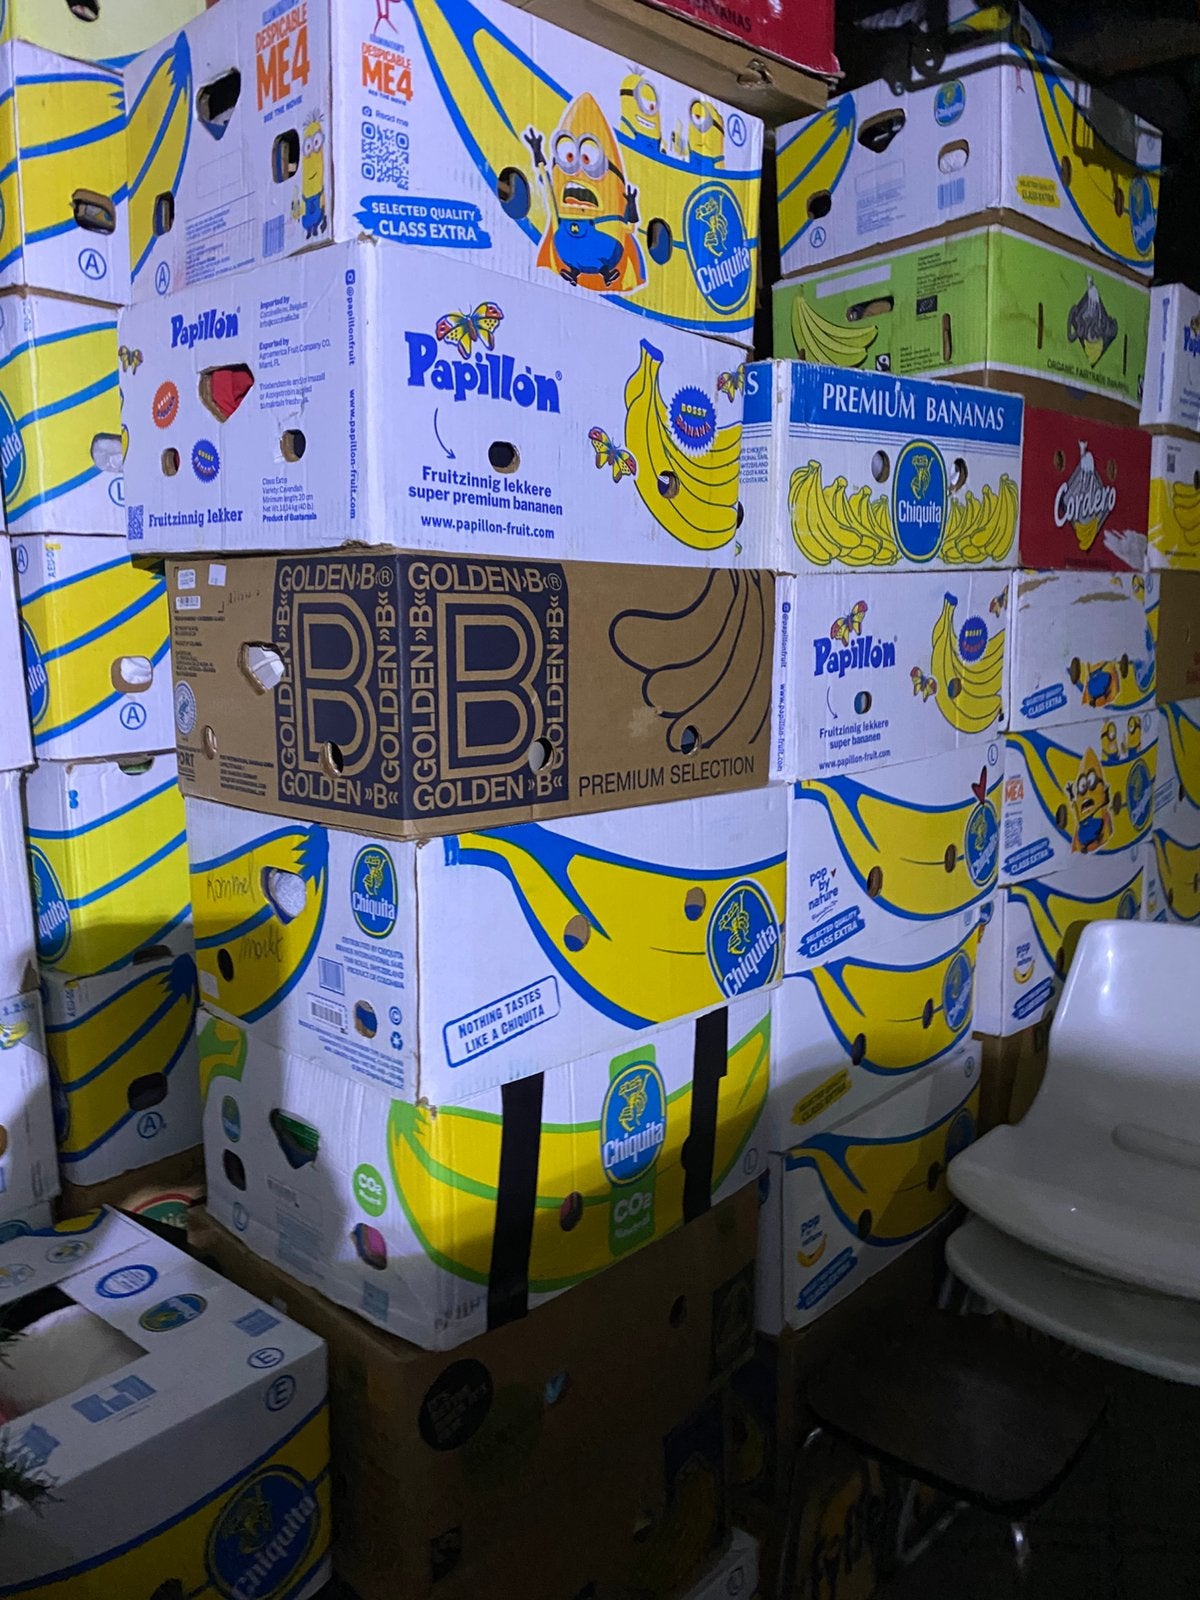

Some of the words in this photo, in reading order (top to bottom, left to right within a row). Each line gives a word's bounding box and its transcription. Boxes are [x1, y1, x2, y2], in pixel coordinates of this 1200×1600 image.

[371, 201, 427, 218] SELECTED
[429, 206, 475, 221] QUALITY
[378, 218, 427, 238] CLASS
[429, 222, 477, 241] EXTRA
[697, 246, 751, 295] Chiquita
[346, 286, 356, 366] @papillonfruit
[681, 402, 707, 417] BOSSY
[822, 382, 916, 420] PREMIUM
[926, 397, 1005, 431] BANANAS
[675, 414, 711, 437] BANANA
[349, 389, 357, 519] www.papillon-fruit.com
[421, 465, 501, 493] Fruitzinnig
[503, 477, 552, 498] lekkere
[408, 485, 450, 502] super
[452, 490, 511, 506] premium
[513, 496, 563, 515] bananen
[899, 500, 942, 529] Chiquita
[1054, 482, 1116, 527] Cordero
[149, 510, 204, 528] Fruitzinnig
[207, 507, 243, 524] lekker
[263, 513, 283, 522] Product
[421, 515, 555, 539] www.papillon-fruit.com
[292, 592, 378, 777] B
[437, 592, 544, 781] B
[377, 645, 400, 784] GOLDEN
[410, 645, 437, 784] GOLDEN
[819, 721, 862, 739] Fruitzinnig
[863, 719, 889, 734] lekkere
[829, 736, 851, 750] super
[852, 732, 881, 747] bananen
[578, 766, 665, 798] PREMIUM
[670, 755, 755, 784] SELECTION
[818, 750, 891, 770] www.papillon-fruit.com
[281, 770, 361, 806] GOLDEN
[412, 778, 524, 812] GOLDEN
[809, 867, 827, 887] pop
[818, 878, 830, 891] by
[352, 890, 396, 921] Chiquita
[808, 887, 839, 911] nature
[809, 934, 834, 954] CLASS
[834, 920, 858, 942] EXTRA
[723, 922, 778, 999] Chiquita
[458, 1005, 503, 1039] NOTHING
[504, 988, 542, 1015] TASTES
[465, 1032, 490, 1054] LIKE
[491, 1028, 500, 1041] A
[500, 1004, 546, 1036] CHIQUITA
[603, 1121, 665, 1169] Chiquita
